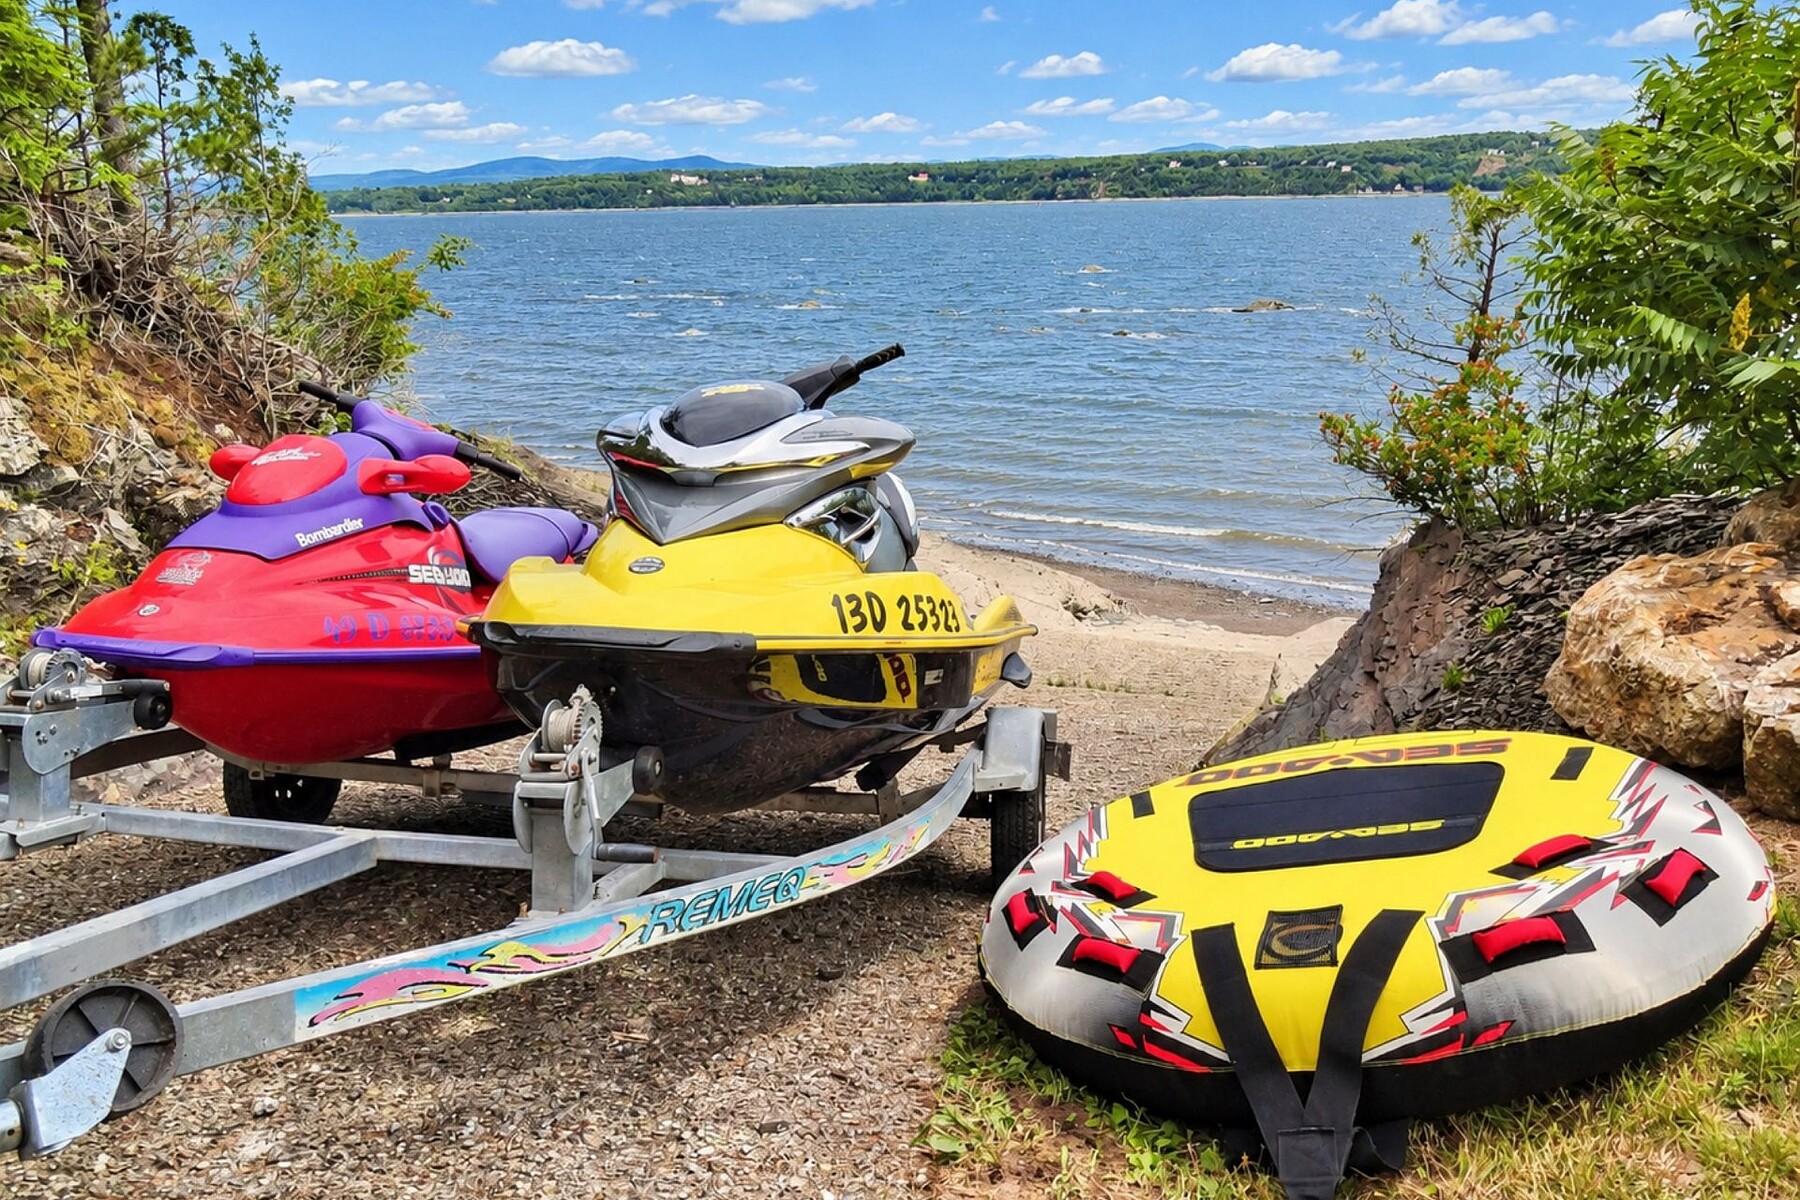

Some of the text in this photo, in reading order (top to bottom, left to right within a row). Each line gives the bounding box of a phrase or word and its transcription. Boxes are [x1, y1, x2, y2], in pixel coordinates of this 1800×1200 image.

[295, 518, 363, 547] Bombardier
[831, 591, 960, 634] 13D 25323
[640, 867, 806, 944] REMEQ
